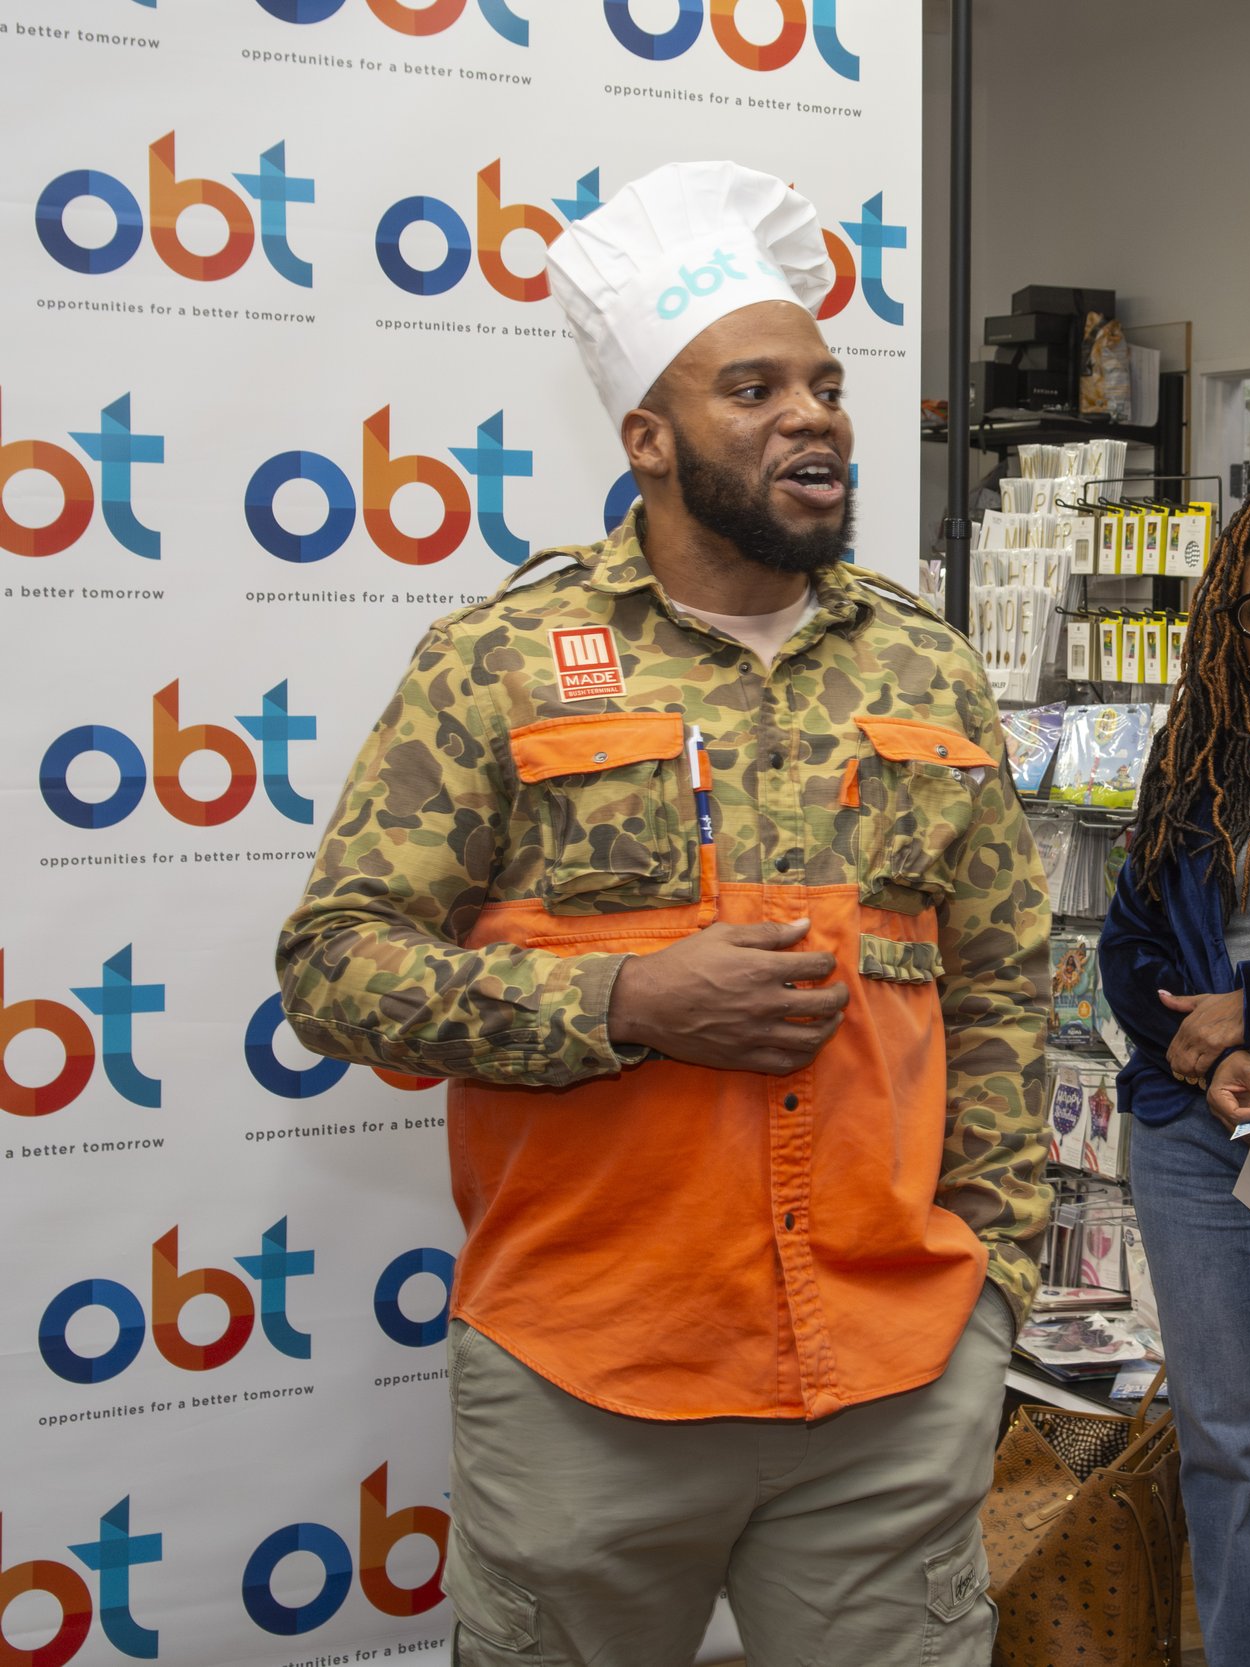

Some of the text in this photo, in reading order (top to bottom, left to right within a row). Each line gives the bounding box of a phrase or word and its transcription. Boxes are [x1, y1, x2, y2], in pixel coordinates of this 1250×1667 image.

[16, 22, 70, 39] better
[77, 29, 160, 49] tomorrow
[241, 48, 532, 86] opportunities for a better tomorrow
[604, 83, 862, 118] opportunities for a better tomorrow
[35, 129, 316, 289] obt
[656, 248, 749, 320] obt
[36, 298, 316, 324] opportunities for a better tomorrow
[375, 319, 471, 333] opportunities
[477, 323, 496, 334] for
[502, 327, 509, 335] a
[514, 326, 556, 338] better
[846, 346, 906, 358] tomorrow
[244, 403, 533, 566] obt
[4, 585, 165, 600] a better tomorrow
[246, 590, 356, 604] opportunities
[362, 590, 385, 603] for
[391, 594, 400, 603] a
[406, 591, 455, 604] better
[565, 671, 617, 687] MADE
[39, 678, 317, 829] obt
[40, 850, 316, 868] opportunities for a better tomorrow
[245, 1115, 445, 1141] opportunities for a bette
[5, 1137, 165, 1158] a better tomorrow
[38, 1215, 315, 1384] obt
[38, 1385, 315, 1426] opportunities for a better tomorrow
[355, 1649, 377, 1663] for
[384, 1647, 392, 1658] a
[398, 1638, 446, 1655] better
